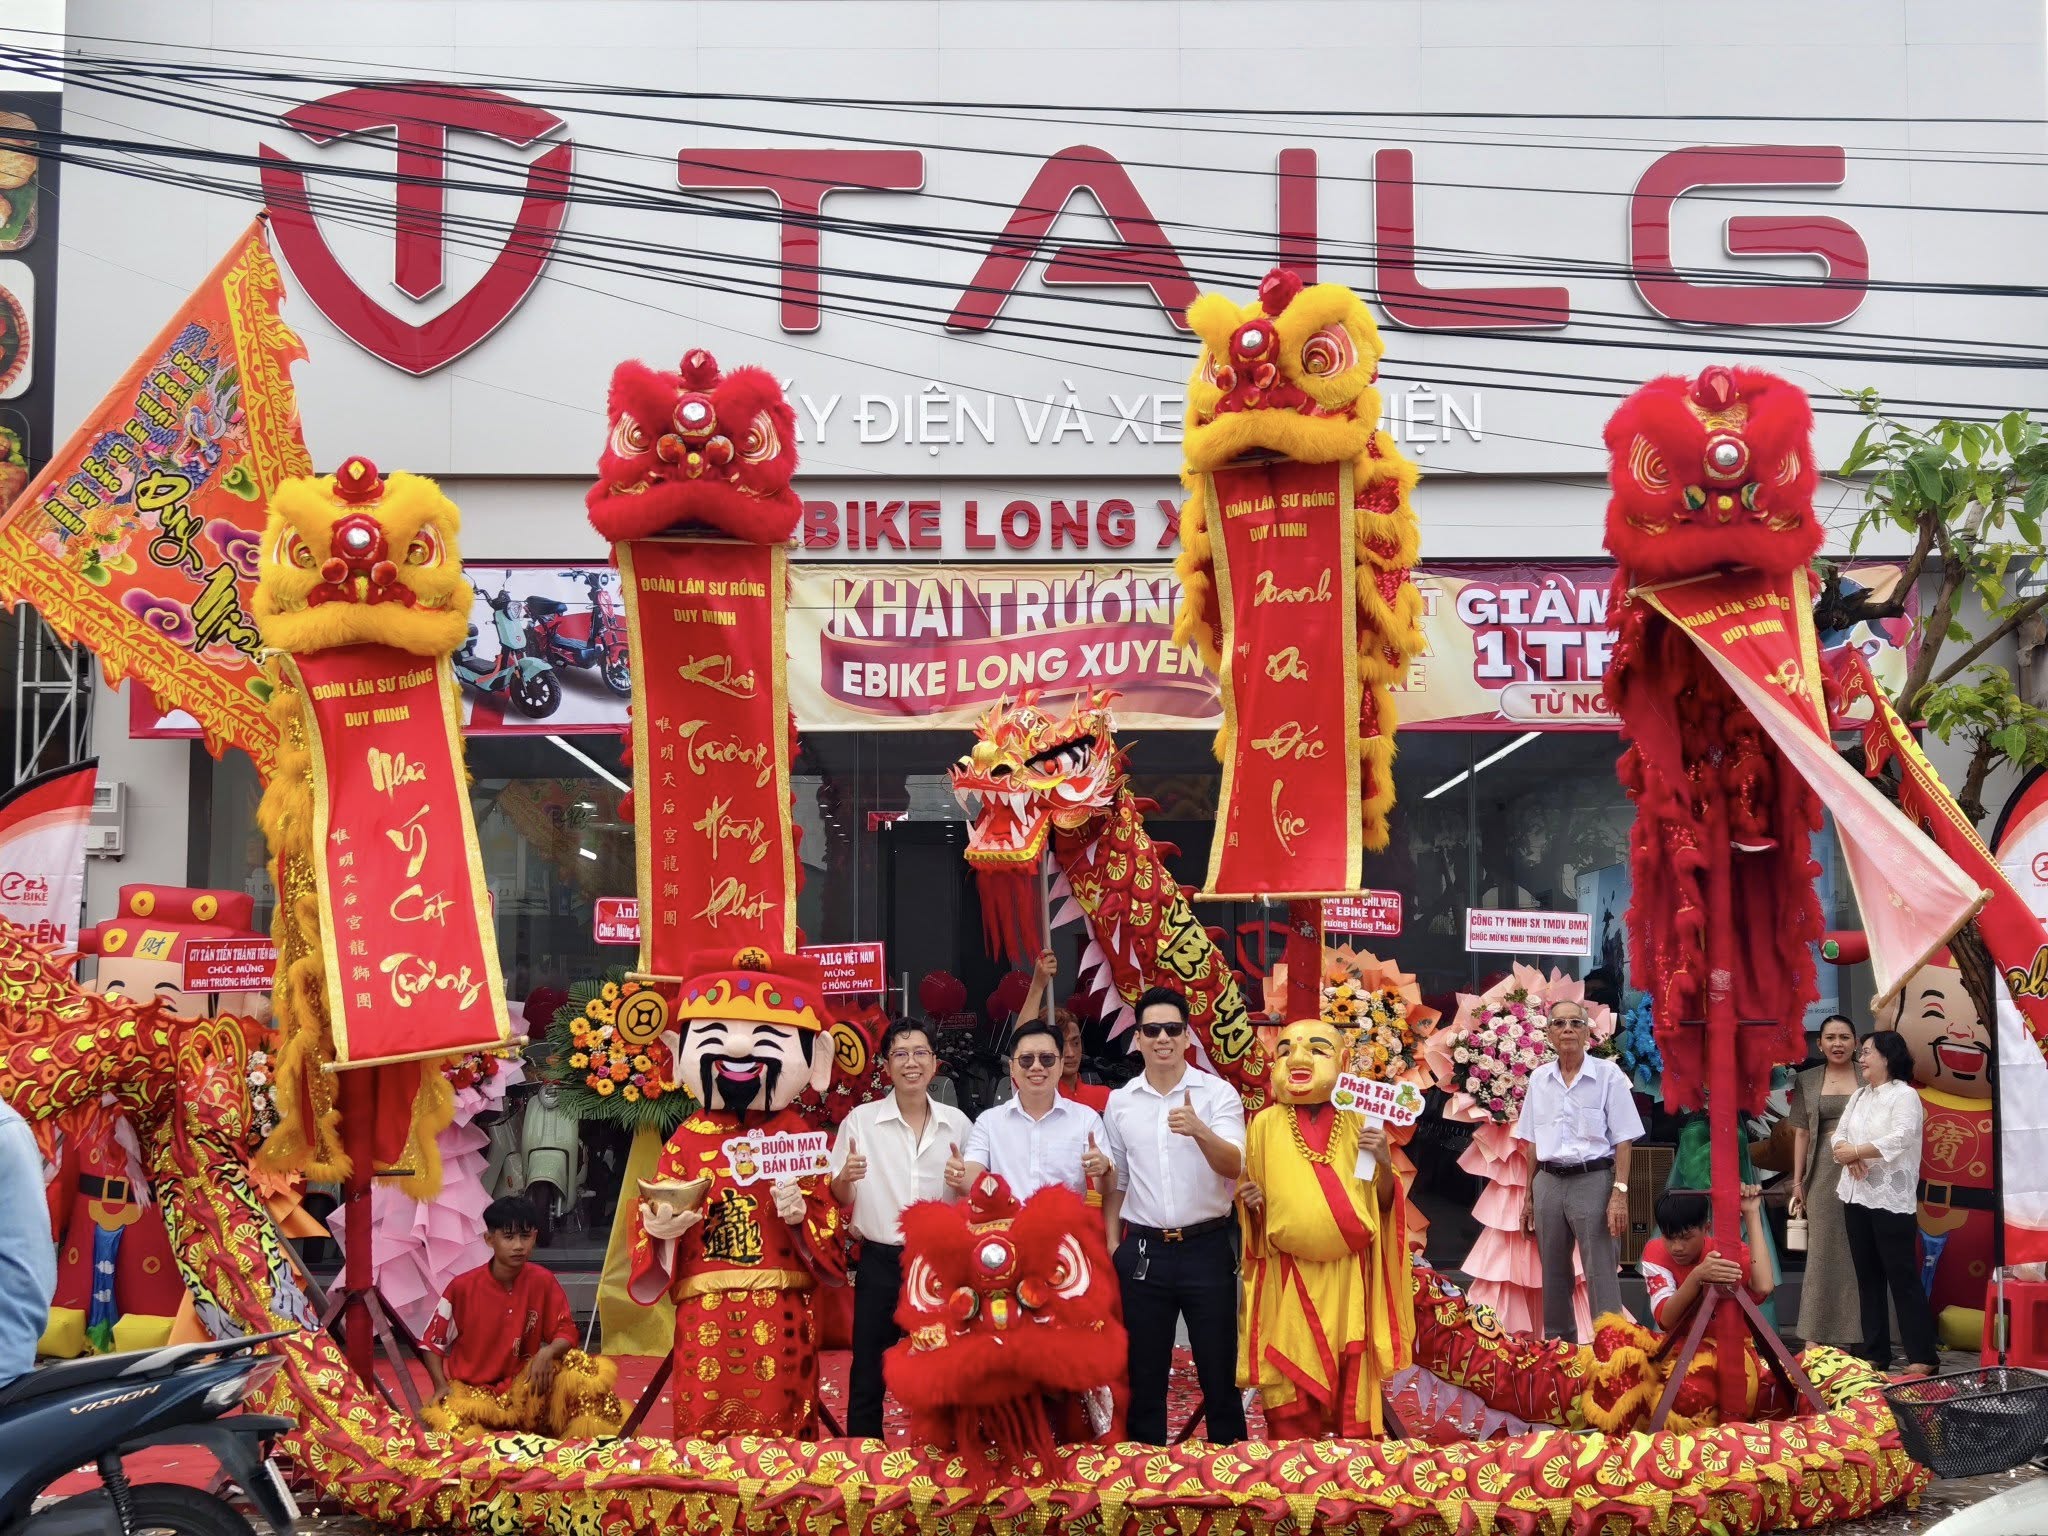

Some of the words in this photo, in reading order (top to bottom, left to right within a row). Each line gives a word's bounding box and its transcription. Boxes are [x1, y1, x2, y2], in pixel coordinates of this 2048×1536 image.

[676, 143, 1871, 334] TAILG
[853, 380, 995, 456] ĐIỆN
[1013, 379, 1094, 444] VÀ
[1109, 394, 1183, 444] XE
[1376, 382, 1482, 454] IỆN
[67, 480, 100, 510] DUY
[1281, 492, 1299, 507] SƯ
[44, 498, 87, 536] MINH
[803, 500, 942, 549] BIKE
[965, 498, 1136, 549] LONG
[1250, 523, 1269, 541] DUY
[640, 575, 675, 593] ĐOÀN
[679, 577, 704, 594] LÂN
[709, 581, 728, 597] SƯ
[730, 577, 766, 598] RỒNG
[674, 608, 698, 623] DUY
[702, 609, 736, 626] MINH
[833, 577, 964, 637] KHAI
[1721, 624, 1750, 645] DUY
[1750, 620, 1784, 636] MINH
[1477, 631, 1513, 678] 1
[312, 680, 346, 700] ĐOÀN
[350, 679, 374, 695] LÂN
[378, 676, 397, 692] SƯ
[399, 667, 433, 690] RỒNG
[678, 654, 757, 699] Khai
[842, 660, 946, 698] EBIKE
[957, 647, 1069, 692] LONG
[1530, 688, 1567, 714] TỪ
[344, 711, 369, 727] DUY
[373, 706, 410, 723] MINH
[23, 892, 48, 901] BIKE
[1336, 906, 1368, 917] EBIKE
[1371, 908, 1386, 919] LX
[1471, 914, 1493, 926] CÔNG
[1495, 916, 1505, 926] TY
[1507, 917, 1528, 928] TNHH
[1530, 918, 1541, 929] SX
[1543, 918, 1566, 930] TMDV
[1568, 920, 1588, 931] BMX
[1324, 920, 1348, 929] rương
[1375, 920, 1396, 931] Phát
[1471, 931, 1488, 941] CHÚC
[1489, 932, 1508, 942] MỪNG
[1510, 934, 1525, 943] KHAI
[1570, 937, 1587, 946] PHÁT
[207, 964, 233, 974] CHÚC
[236, 963, 264, 973] MỪNG
[813, 952, 842, 965] AILG
[844, 949, 858, 966] VIỆT
[860, 951, 875, 963] NAM
[191, 978, 208, 988] KHAI
[824, 969, 855, 978] MỪNG
[852, 978, 873, 988] PHÁT
[1340, 1077, 1371, 1096] Phát
[1375, 1085, 1395, 1101] Tài
[1355, 1096, 1387, 1115] Phát
[1389, 1105, 1412, 1122] Lộc
[761, 1137, 794, 1155] BUÔN
[797, 1136, 822, 1153] MAY
[763, 1155, 787, 1174] BÁN
[70, 1384, 161, 1414] VISION
